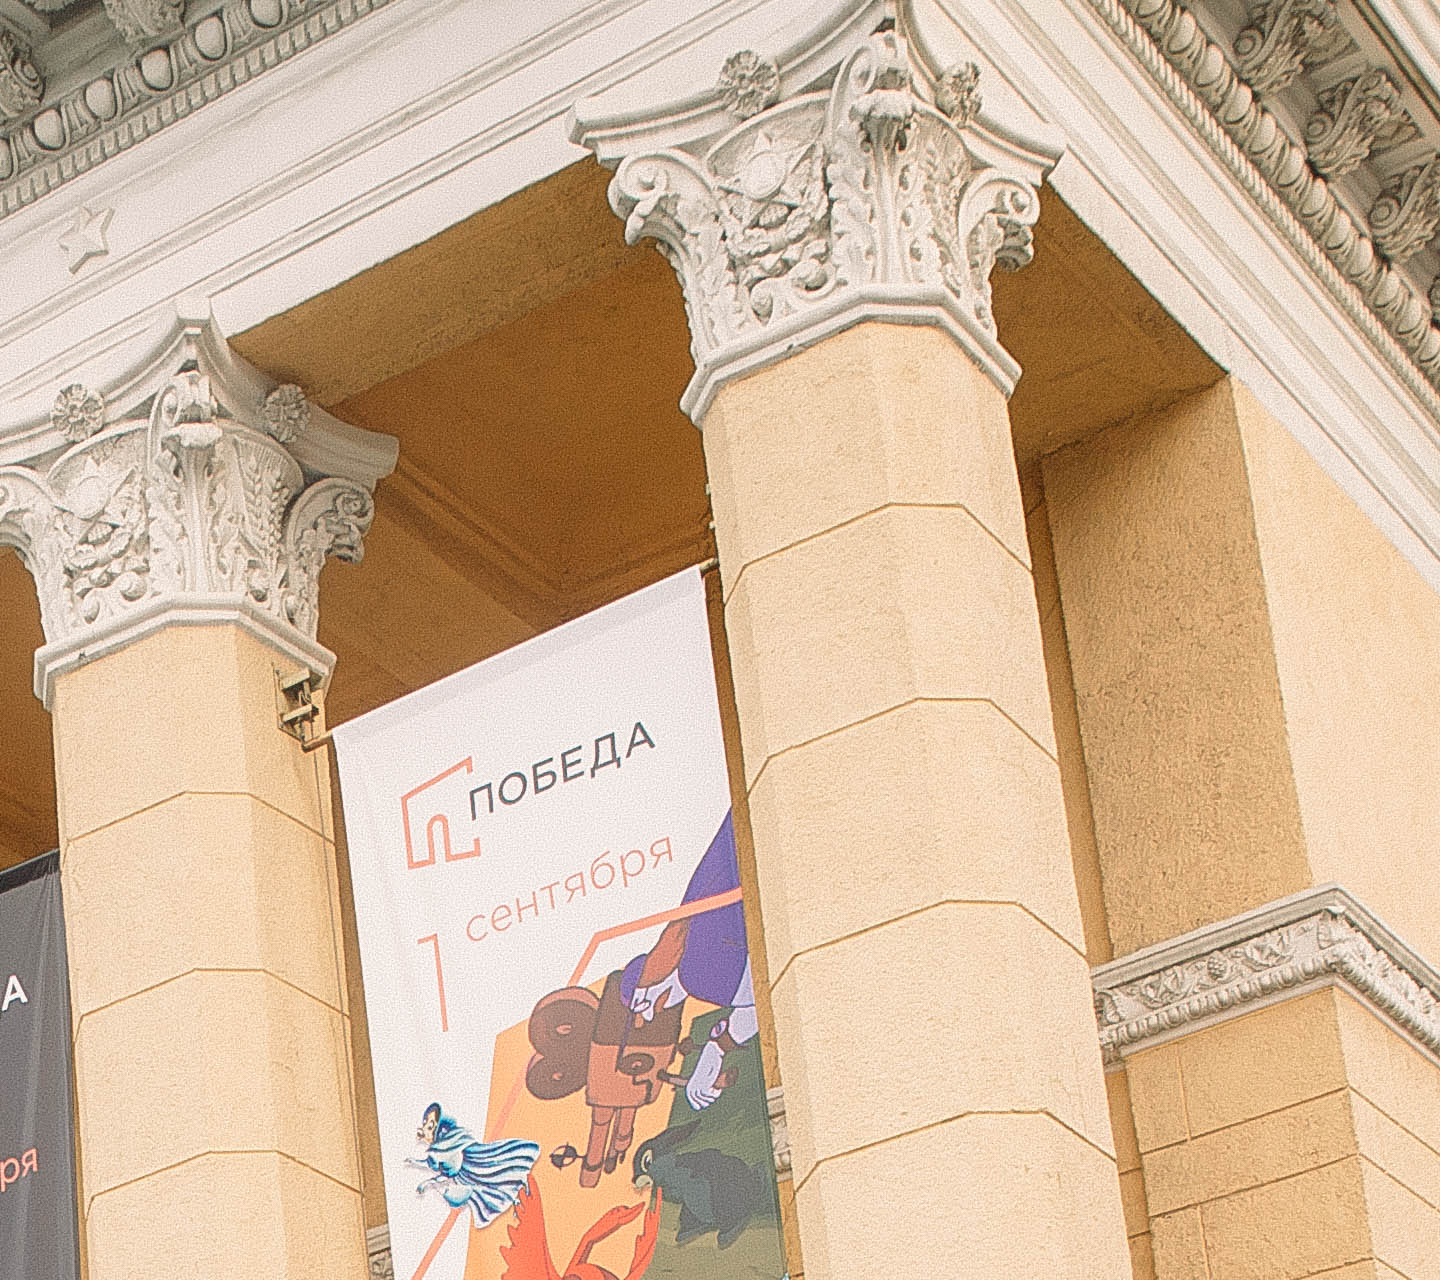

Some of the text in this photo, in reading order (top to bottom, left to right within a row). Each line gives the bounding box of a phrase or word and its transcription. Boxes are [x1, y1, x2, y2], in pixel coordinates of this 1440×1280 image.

[468, 721, 657, 821] ПОБЕДА
[418, 836, 674, 1033] 1 сентября
